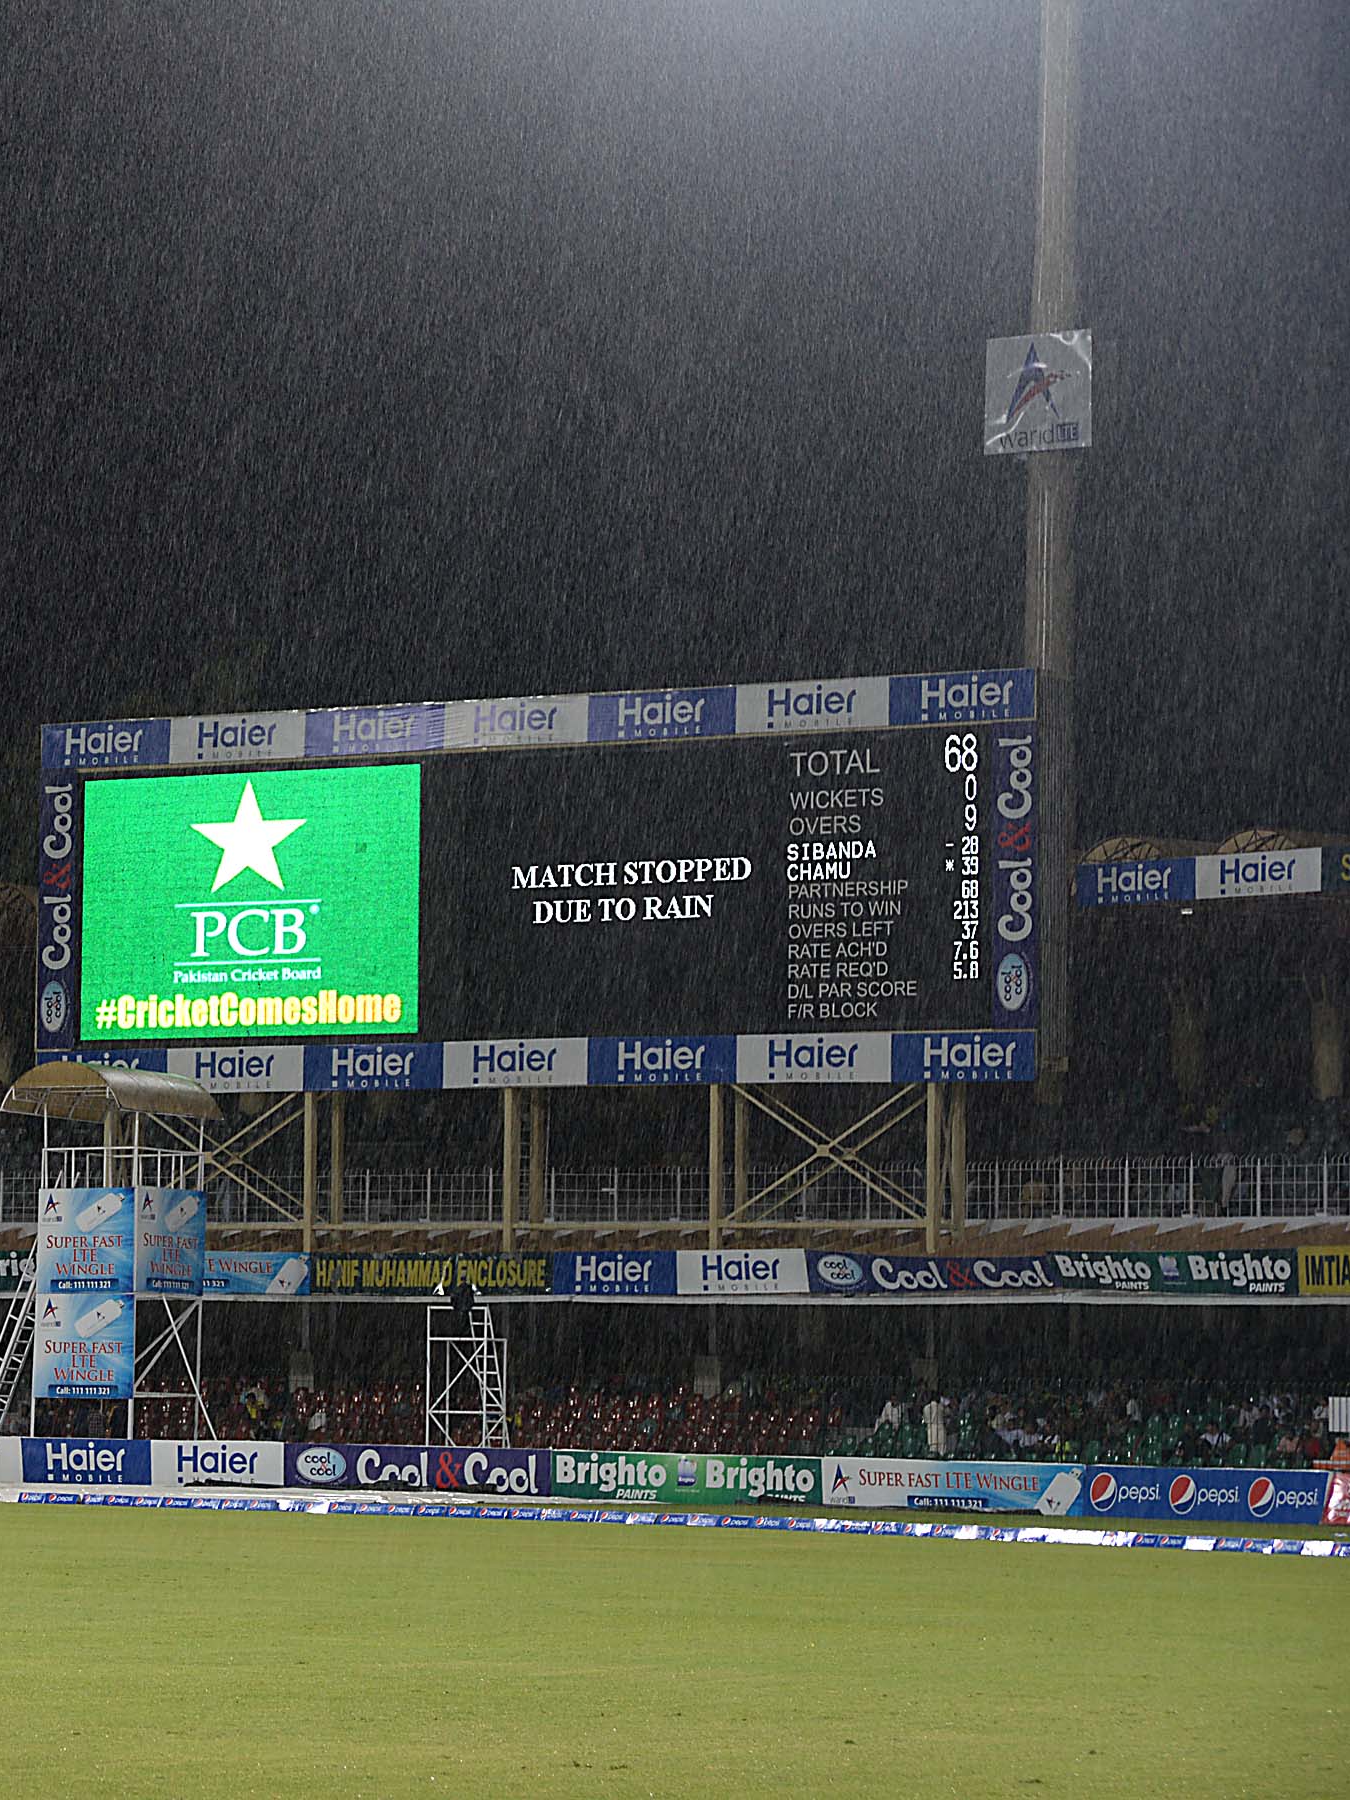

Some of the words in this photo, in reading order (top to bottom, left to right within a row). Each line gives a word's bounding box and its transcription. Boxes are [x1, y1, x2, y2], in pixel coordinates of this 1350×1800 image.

[768, 685, 856, 718] Haier
[921, 675, 1012, 709] Haier
[474, 697, 556, 732] Haier
[618, 694, 704, 726] Haier
[198, 717, 277, 750] Haier
[333, 708, 414, 742] Haier
[635, 726, 701, 737] MOBILE
[65, 724, 143, 756] Haier
[79, 755, 140, 766] MOBILE
[790, 750, 880, 776] TOTAL
[945, 734, 977, 772] 68
[997, 735, 1033, 819] Cool
[790, 789, 884, 810] WICKETS
[965, 774, 977, 800] 0
[43, 784, 73, 859] Cool
[790, 815, 861, 836] OVERS
[965, 804, 977, 831] 9
[787, 840, 876, 861] SIBANDA
[962, 836, 978, 855] 28
[999, 821, 1031, 852] &
[43, 863, 71, 888] &
[511, 863, 617, 889] MATCH
[623, 857, 751, 884] STOPPED
[787, 862, 851, 881] CHAMU
[962, 856, 978, 875] 39
[1098, 864, 1171, 893] Haier
[1220, 856, 1295, 884] Haier
[789, 880, 908, 899] PARTNERSHIP
[962, 880, 978, 898] 68
[997, 857, 1033, 941] Cool
[533, 900, 592, 924] DUE
[598, 898, 636, 921] TO
[642, 895, 714, 920] RAIN
[789, 903, 835, 919] RUNS
[841, 902, 863, 917] TO
[868, 900, 900, 916] WIN
[954, 901, 978, 920] 213
[42, 894, 72, 969] Cool
[191, 908, 306, 958] PCB
[789, 923, 846, 940] OVERS
[852, 921, 894, 937] LEFT
[962, 921, 978, 940] 37
[788, 943, 830, 959] RATE
[836, 942, 887, 958] ACH'D
[954, 941, 978, 960] 7.6
[174, 969, 228, 983] Pakistan
[231, 968, 278, 982] Cricket
[282, 966, 321, 980] Board
[788, 963, 830, 979] RATE
[836, 962, 888, 978] REQ'D
[954, 962, 978, 980] 5.8
[788, 983, 813, 999] D/L
[819, 982, 851, 998] PAR
[857, 981, 917, 996] SCORE
[96, 991, 401, 1029] #CricketComesHome
[788, 1003, 814, 1018] F/R
[820, 1002, 877, 1018] BLOCK
[331, 1047, 414, 1078] Haier
[473, 1039, 556, 1074] Haier
[617, 1040, 705, 1072] Haier
[769, 1037, 858, 1070] Haier
[923, 1036, 1014, 1069] Haier
[195, 1052, 274, 1082] Haier
[634, 1072, 702, 1082] MOBILE
[941, 1070, 1012, 1080] MOBILE
[347, 1079, 411, 1088] MOBILE
[47, 1235, 89, 1248] SUPER
[93, 1235, 123, 1247] FAST
[73, 1249, 97, 1262] LTE
[56, 1263, 114, 1275] WINGLE
[217, 1259, 273, 1274] WINGLE
[316, 1260, 359, 1288] HANIF
[363, 1257, 451, 1288] MUHAMMAD
[456, 1259, 546, 1288] ENCLOSURE
[575, 1255, 652, 1282] Haier
[702, 1253, 779, 1281] Haier
[871, 1258, 947, 1290] Cool
[947, 1261, 976, 1289] &
[973, 1260, 1054, 1287] Cool
[1054, 1253, 1151, 1284] Brighto
[1188, 1252, 1291, 1286] Brighto
[590, 1284, 650, 1292] MOBILE
[1116, 1281, 1149, 1290] PAINTS
[1250, 1282, 1285, 1293] PAINTS
[45, 1340, 88, 1353] SUPER
[92, 1342, 122, 1354] FAST
[72, 1355, 95, 1367] LTE
[54, 1368, 114, 1381] WINGLE
[46, 1442, 125, 1472] Haier
[177, 1445, 258, 1474] Haier
[305, 1451, 331, 1464] cool
[310, 1464, 337, 1476] cool
[63, 1474, 123, 1483] MOBILE
[435, 1451, 463, 1489] &
[464, 1452, 538, 1494] Cool
[556, 1452, 667, 1492] Brighto
[706, 1456, 815, 1498] Brighto
[858, 1468, 905, 1487] SUPER
[908, 1472, 941, 1489] FAST
[946, 1472, 972, 1490] LTE
[977, 1473, 1039, 1492] WINGLE
[616, 1488, 657, 1500] PAINTS
[914, 1497, 932, 1506] Call:
[967, 1499, 982, 1508] 321
[1118, 1484, 1160, 1503] pepsi
[1197, 1486, 1239, 1505] pepsi
[1276, 1488, 1318, 1508] pepsi
